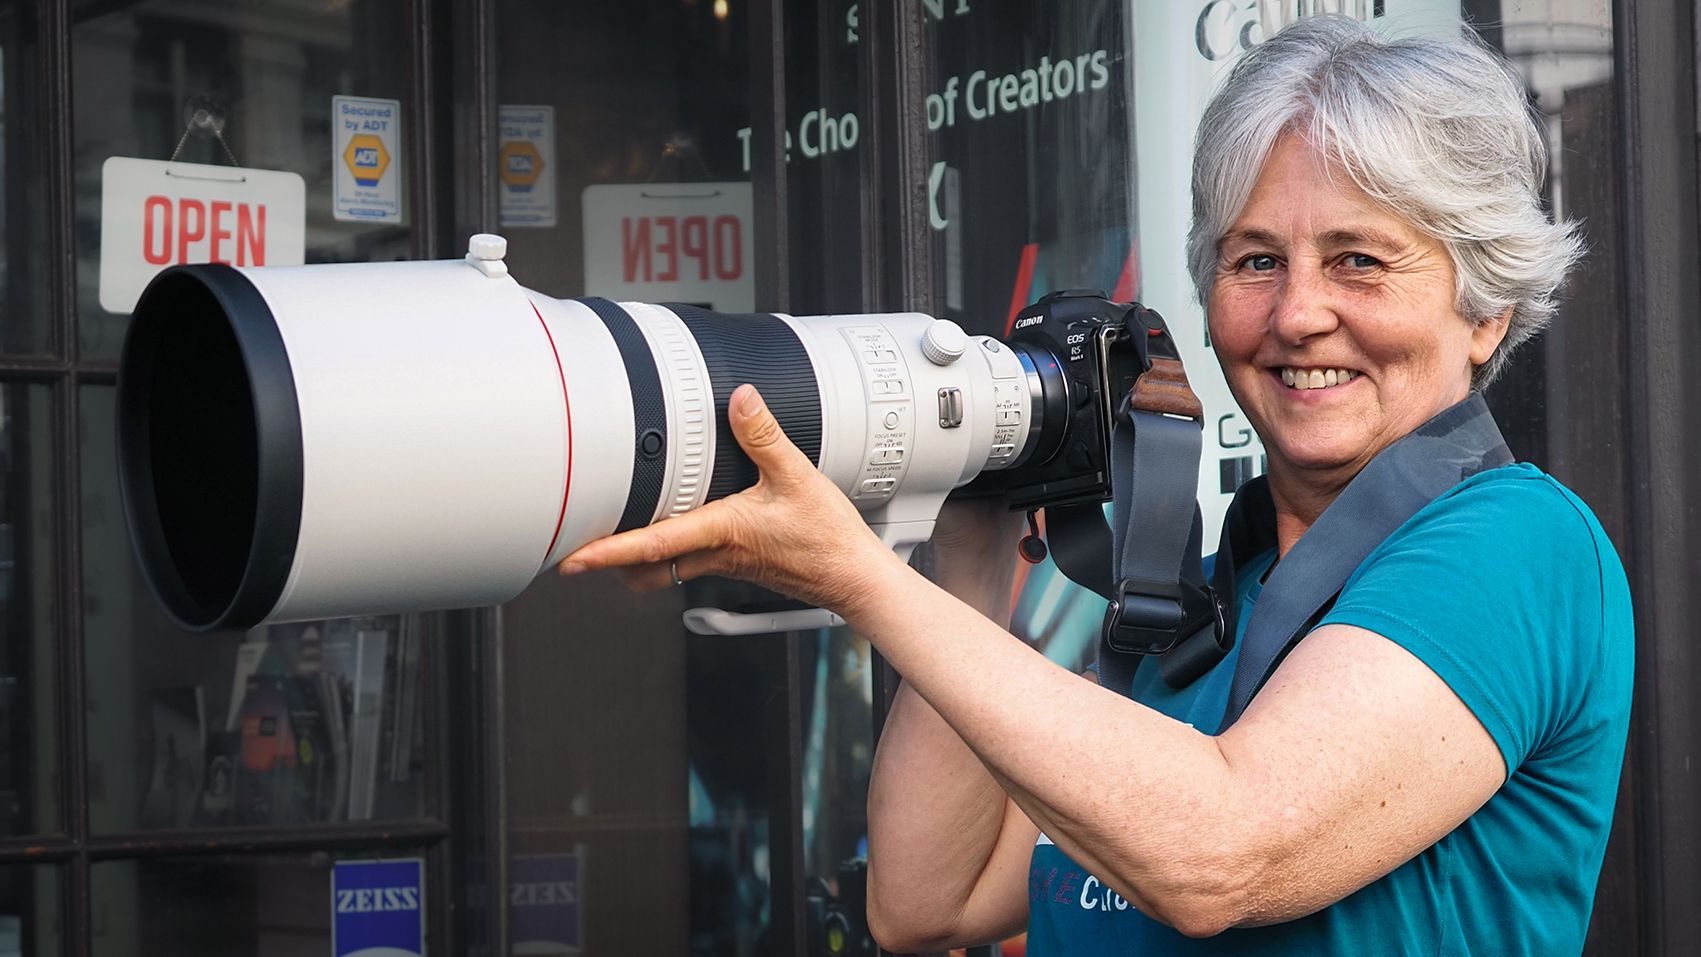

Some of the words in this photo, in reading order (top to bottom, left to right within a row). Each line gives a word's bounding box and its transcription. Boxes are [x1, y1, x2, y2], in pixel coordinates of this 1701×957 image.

[799, 107, 859, 158] Cho
[926, 76, 959, 131] of
[966, 49, 1110, 121] Creators
[342, 104, 391, 118] Secured
[345, 118, 359, 131] by
[363, 121, 388, 131] ADT
[143, 194, 266, 268] OPEN
[1015, 315, 1044, 330] Canon
[1067, 333, 1085, 344] EOS
[1071, 345, 1081, 356] R5
[337, 887, 418, 914] ZEISS
